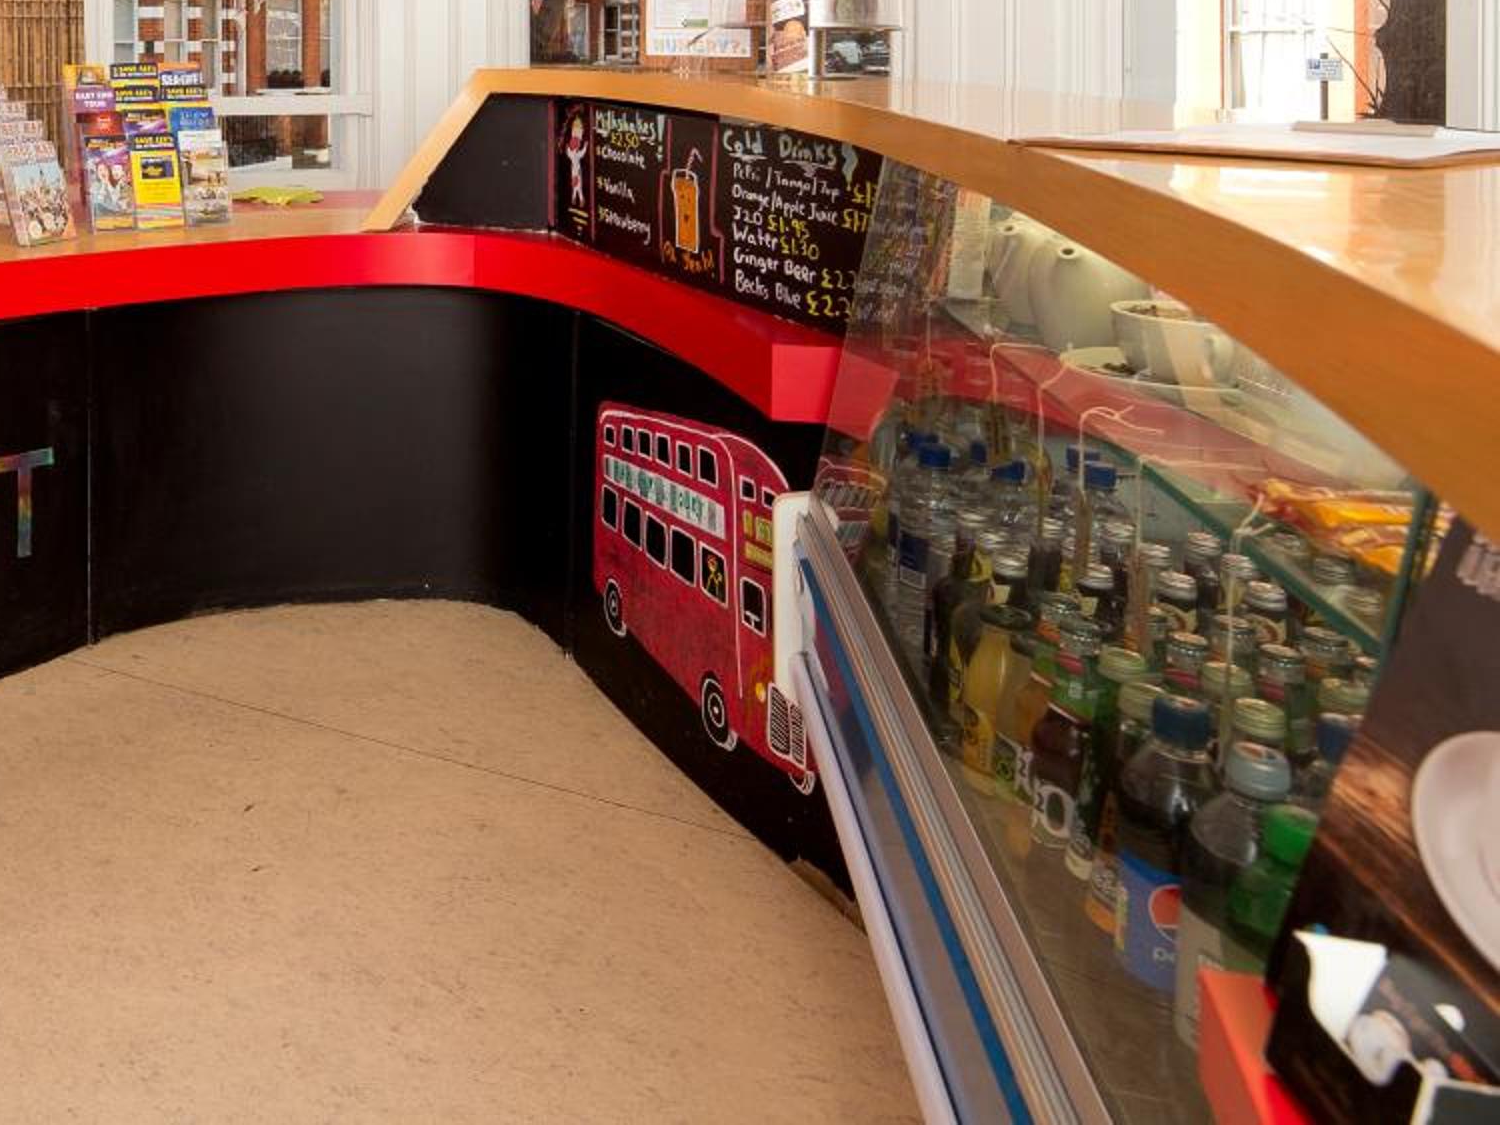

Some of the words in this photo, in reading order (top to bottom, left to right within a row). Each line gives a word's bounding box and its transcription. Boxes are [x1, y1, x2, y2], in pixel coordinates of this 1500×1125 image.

[723, 129, 764, 156] Cold
[732, 222, 779, 251] Water
[734, 247, 779, 273] Ginger
[784, 260, 817, 284] Beer
